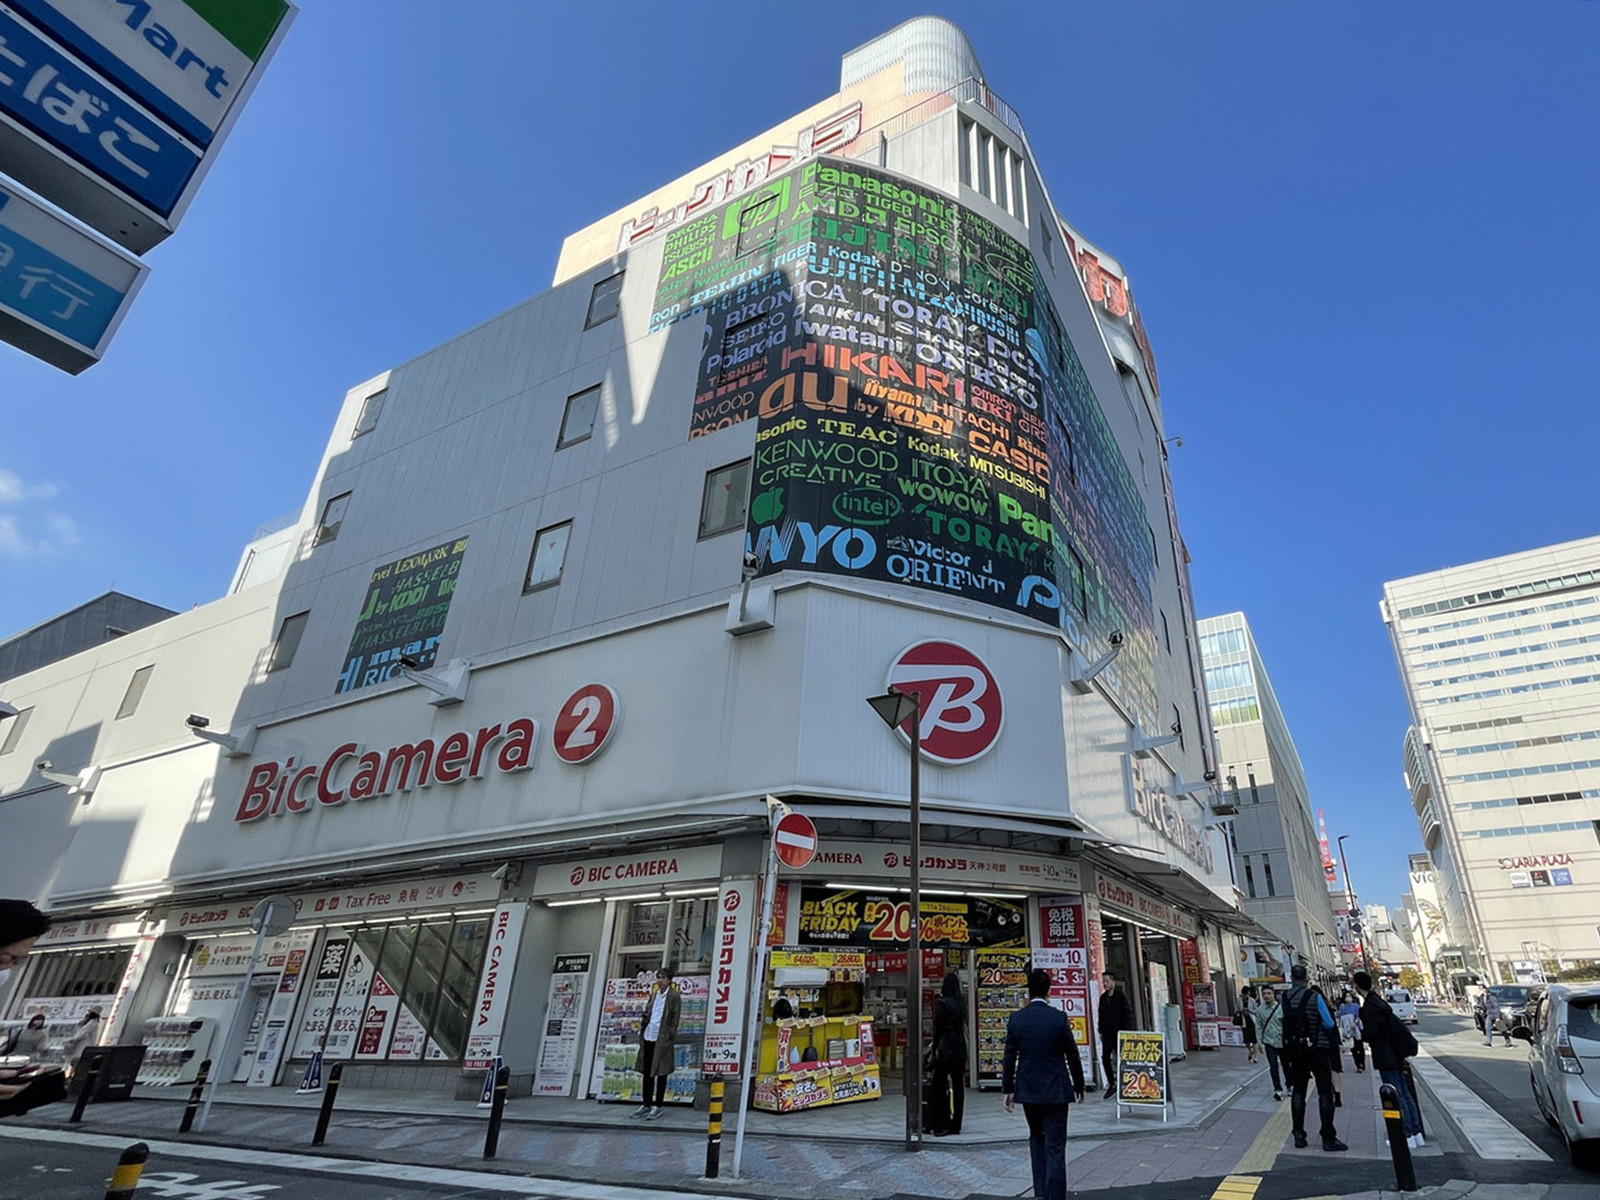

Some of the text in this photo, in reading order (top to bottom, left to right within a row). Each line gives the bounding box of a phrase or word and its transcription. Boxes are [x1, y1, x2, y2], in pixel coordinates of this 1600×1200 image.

[661, 245, 713, 283] ASCII
[781, 342, 966, 402] HIKARI
[758, 370, 850, 420] au
[817, 417, 898, 446] TEAC
[756, 438, 899, 473] KENWOOD
[907, 436, 1047, 500] Kodak MITSUBISHI
[759, 463, 882, 489] CREATIVE
[842, 494, 891, 517] intel
[898, 477, 988, 517] WOWOW
[235, 717, 537, 823] BicCamera
[588, 858, 679, 883] BIC CAMERA
[1541, 854, 1575, 867] PLAZA
[346, 894, 365, 909] Tax
[366, 891, 392, 906] Free
[802, 901, 858, 916] BLACK
[800, 914, 861, 934] FRIDAY
[1048, 907, 1075, 922] 免税
[320, 944, 346, 975] 薬
[477, 911, 510, 1028] BIC CAMERA
[713, 915, 737, 1025] ビックカメラ
[1122, 1051, 1162, 1062] FRIDAY
[1124, 1042, 1160, 1052] BLACK
[715, 1062, 732, 1072] FREE
